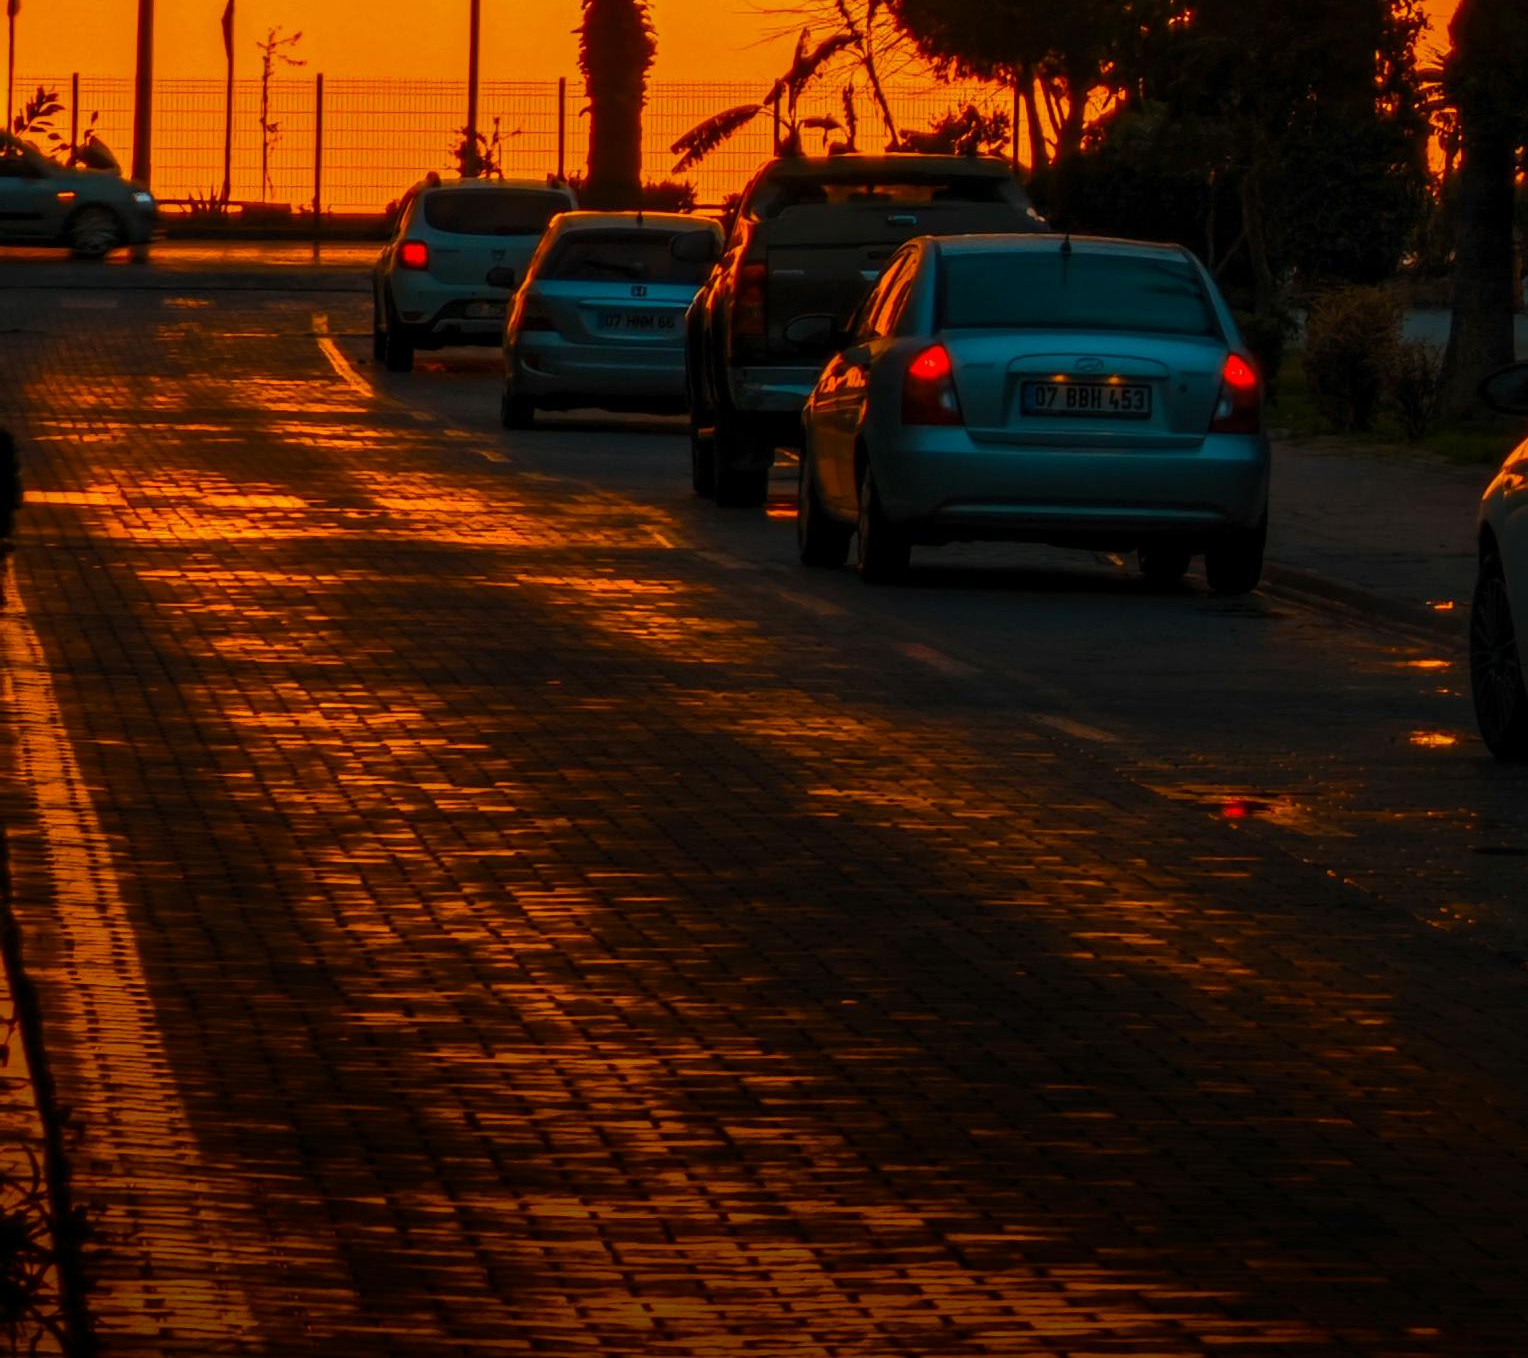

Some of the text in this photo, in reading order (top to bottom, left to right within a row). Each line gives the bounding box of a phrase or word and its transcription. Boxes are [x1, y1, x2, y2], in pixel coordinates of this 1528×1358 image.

[1036, 386, 1145, 410] 07 BBH 453
